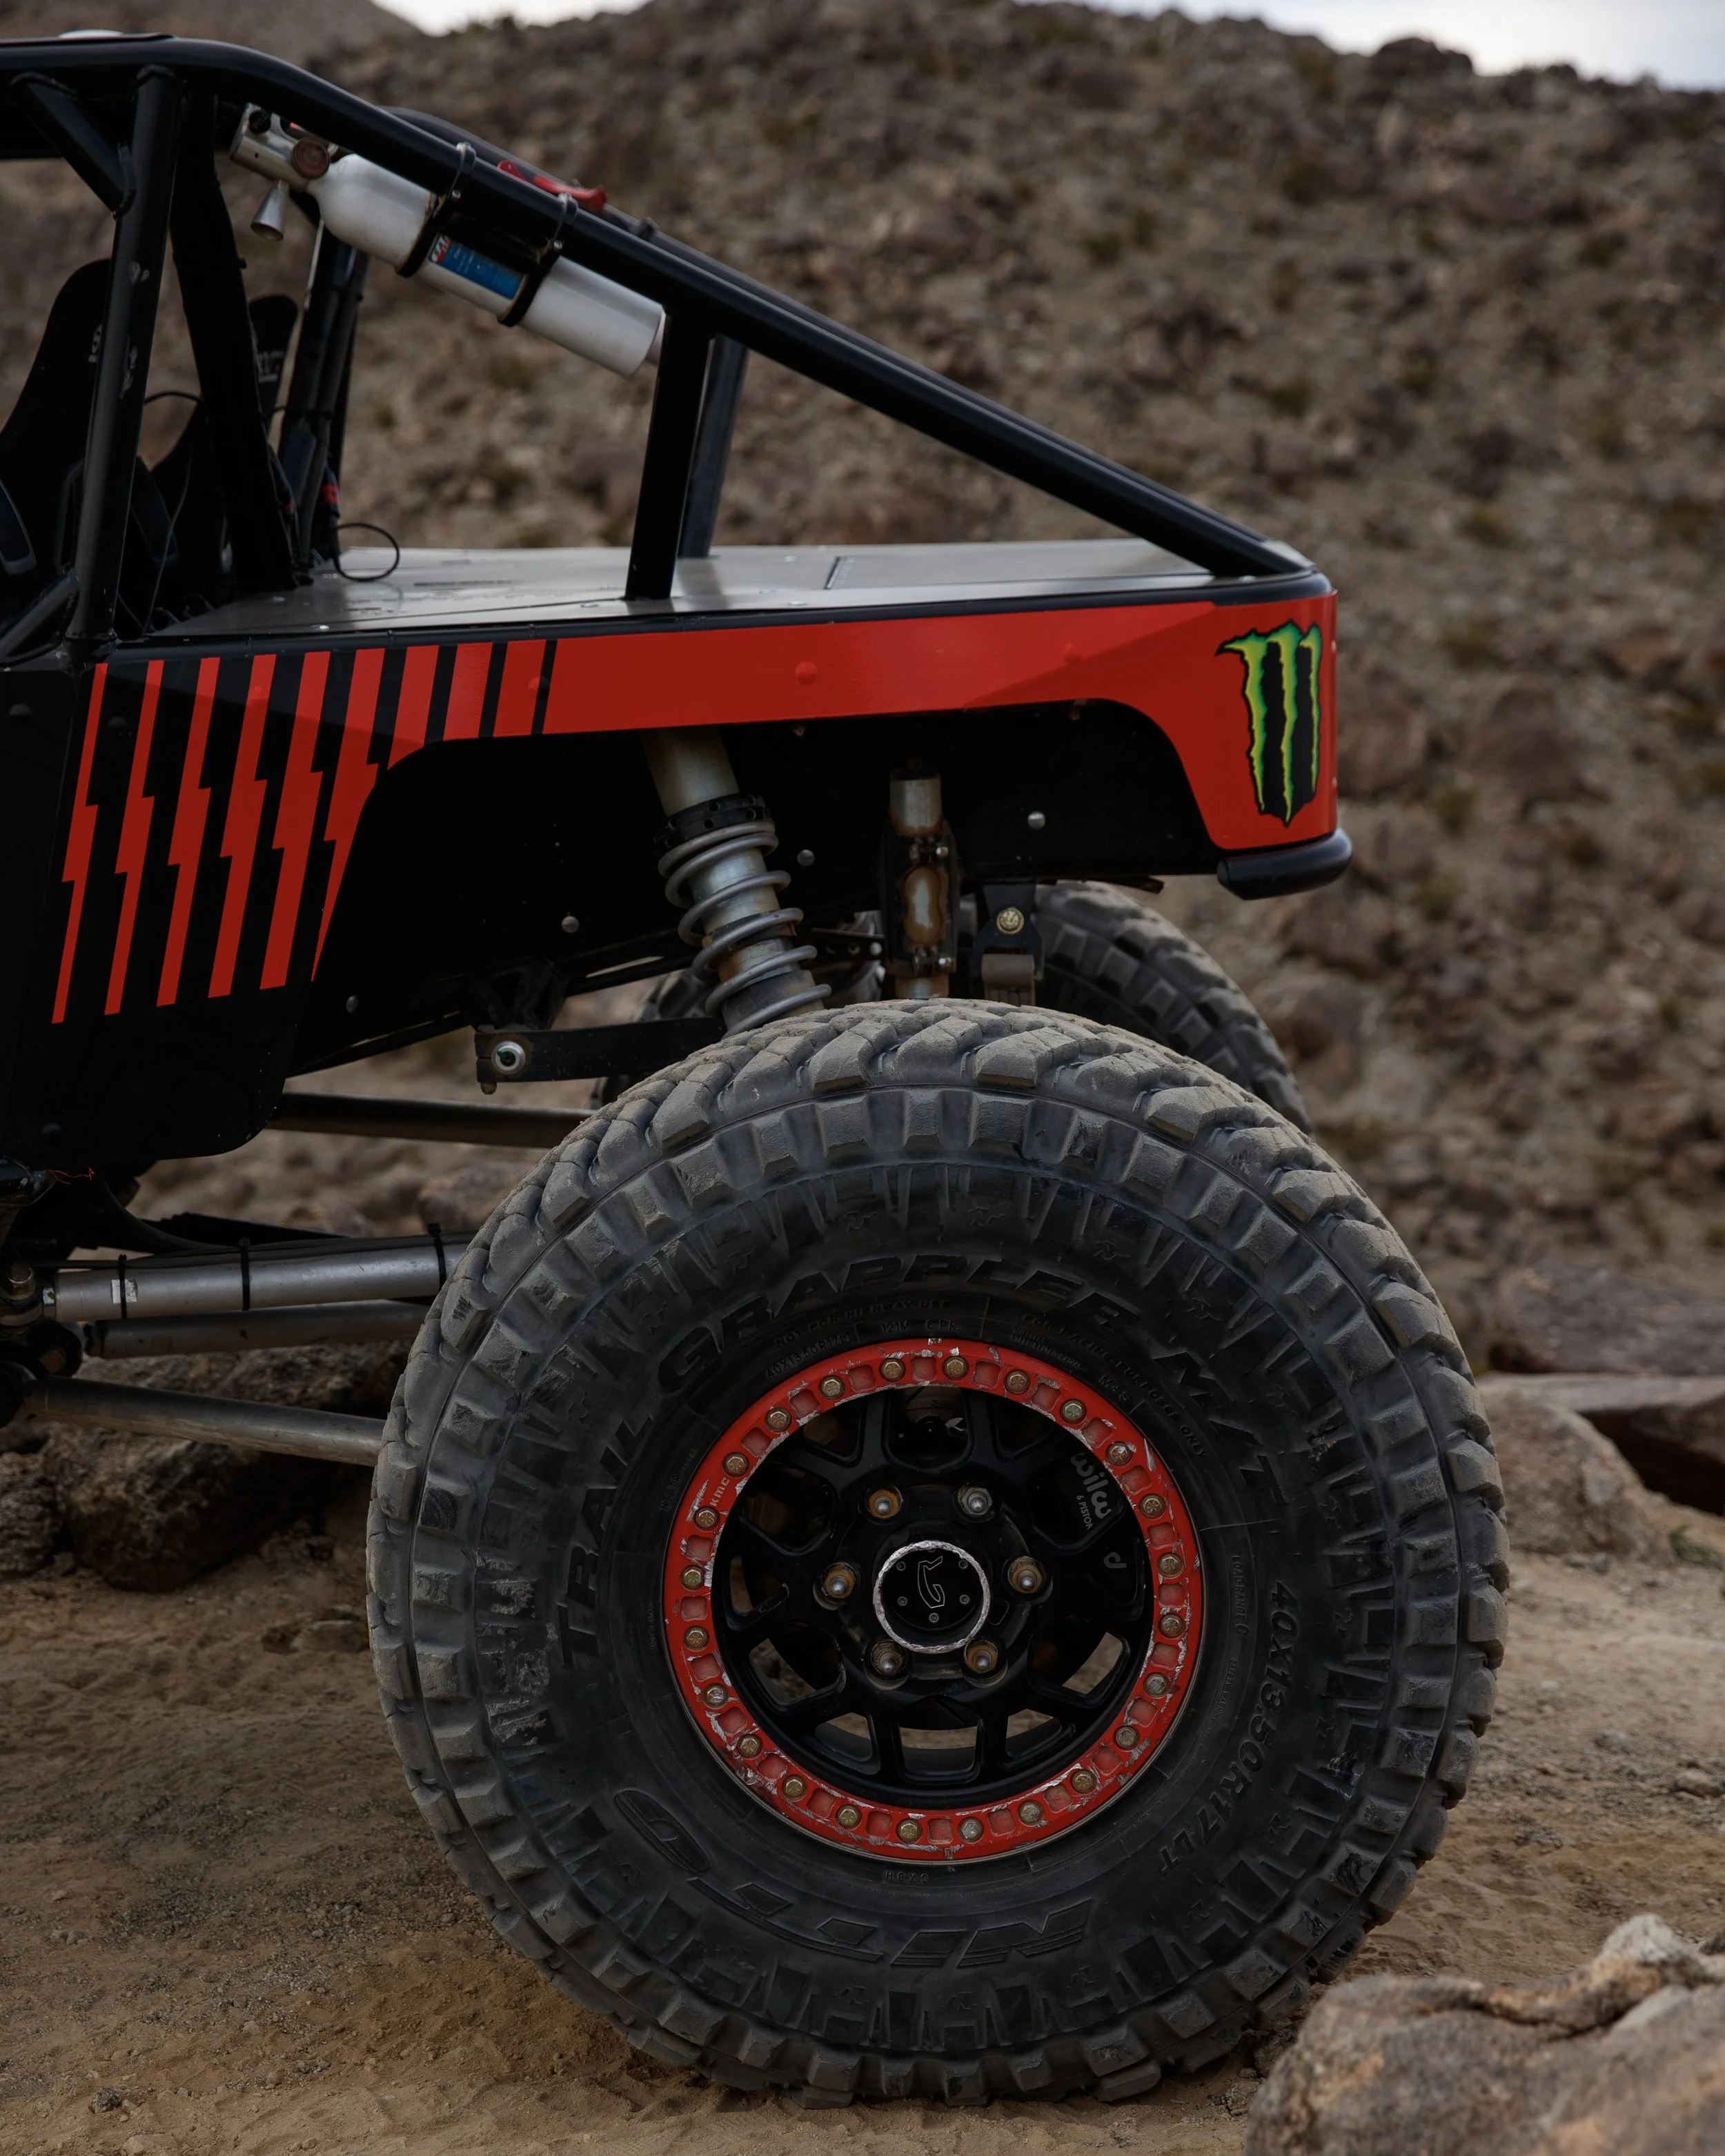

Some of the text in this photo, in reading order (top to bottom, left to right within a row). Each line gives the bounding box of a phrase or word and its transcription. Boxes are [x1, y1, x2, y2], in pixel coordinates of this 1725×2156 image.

[776, 1299, 952, 1347] NOT FOR HIGHWAY USE
[558, 1414, 654, 1668] TRAIL
[657, 1254, 1142, 1393] GRAPPLER
[1078, 1500, 1094, 1530] PISTON
[1232, 1555, 1243, 1585] LOAD
[1233, 1585, 1247, 1622] RANGE
[1160, 1581, 1298, 1877] 40X13.50R17LT
